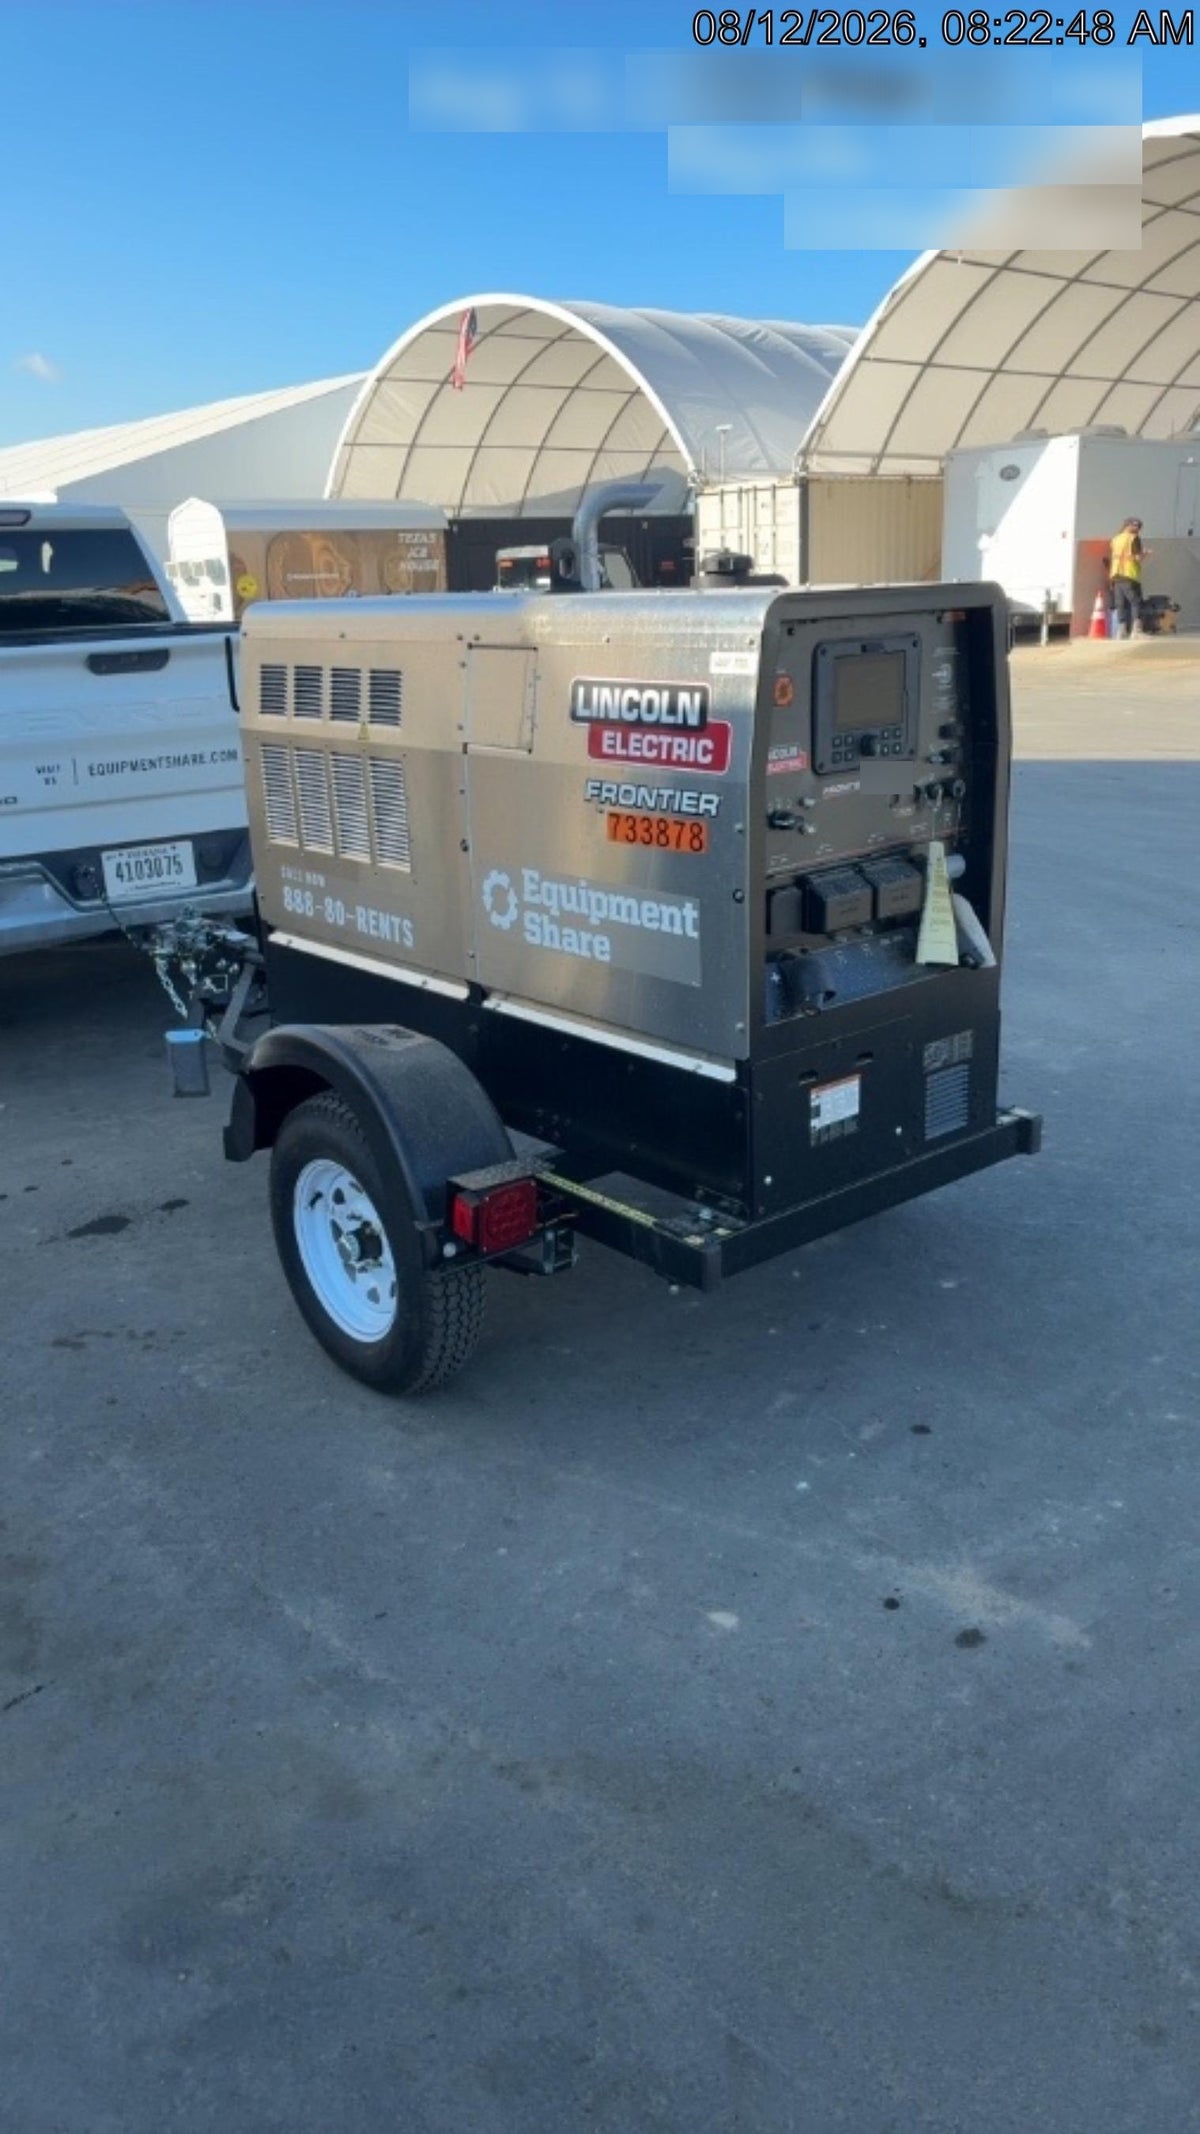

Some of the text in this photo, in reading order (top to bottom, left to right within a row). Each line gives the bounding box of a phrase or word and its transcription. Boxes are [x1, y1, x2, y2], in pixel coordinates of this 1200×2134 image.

[398, 532, 437, 544] TEXAS
[575, 684, 701, 727] LINCOLN
[88, 749, 238, 777] EQUIPMENTSHARE.COM
[601, 730, 714, 765] ELECTRIC
[584, 779, 722, 818] FRONTIER
[607, 812, 704, 852] 733878
[115, 853, 184, 883] 4103075
[282, 886, 415, 949] 888-80-RENTS
[521, 867, 699, 939] Equipment
[523, 909, 612, 963] Share
